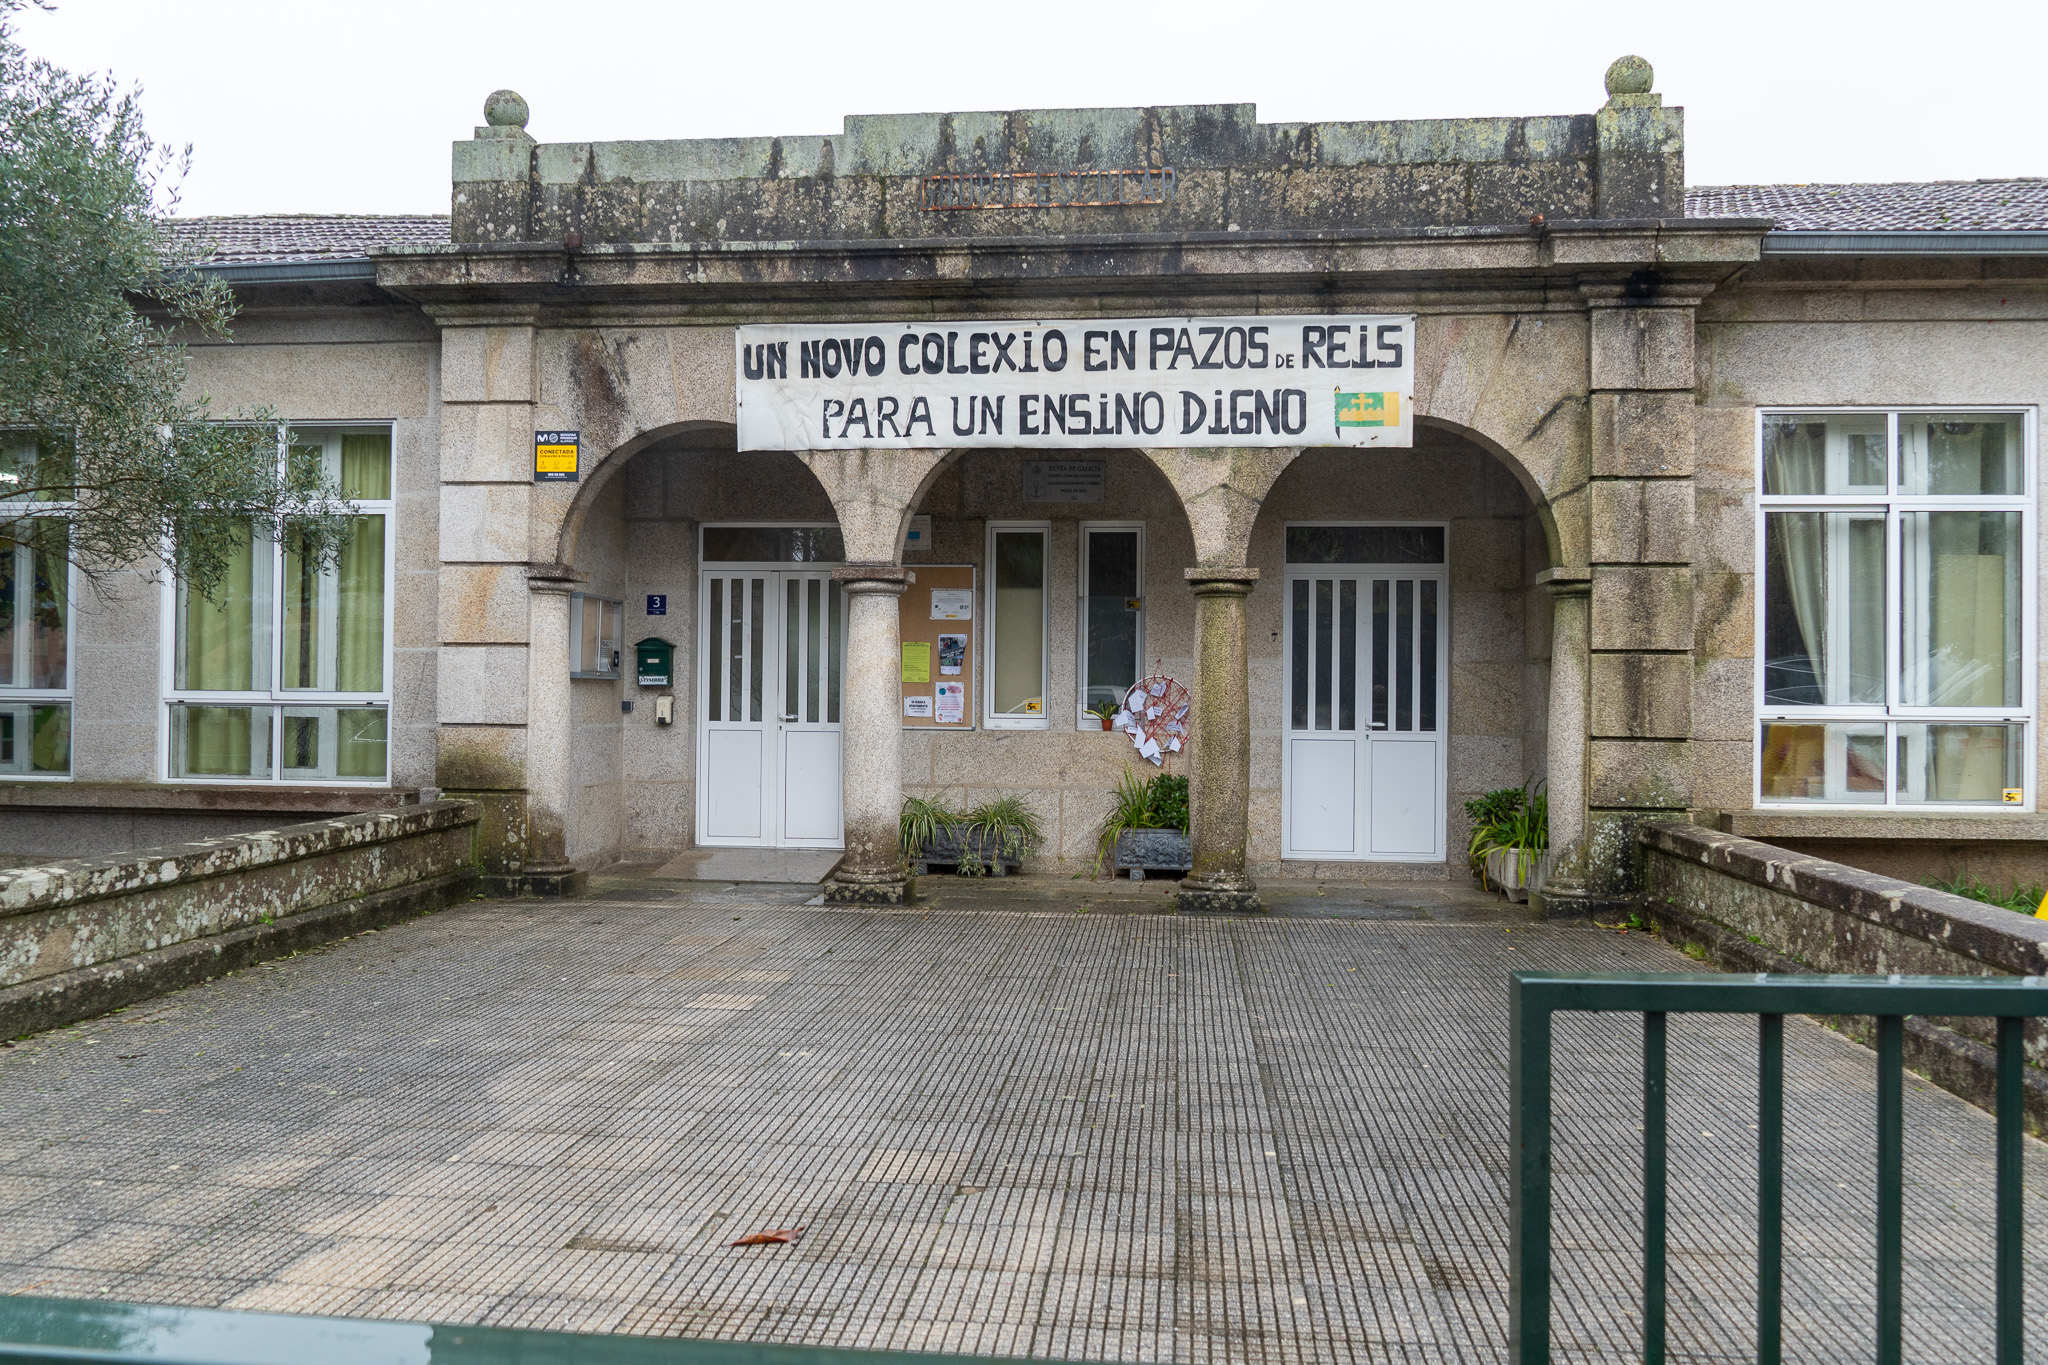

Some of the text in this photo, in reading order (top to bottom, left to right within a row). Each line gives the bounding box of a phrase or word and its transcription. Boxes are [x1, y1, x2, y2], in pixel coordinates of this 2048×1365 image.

[920, 166, 1176, 209] GRUPO ESCOLAR
[743, 341, 789, 380] UN
[800, 335, 886, 379] NOVO
[1083, 329, 1138, 372] EN
[1149, 326, 1269, 371] PAZOS
[1275, 353, 1295, 369] DE
[823, 396, 937, 439] PARA
[950, 395, 1006, 437] UN
[653, 597, 660, 608] 3
